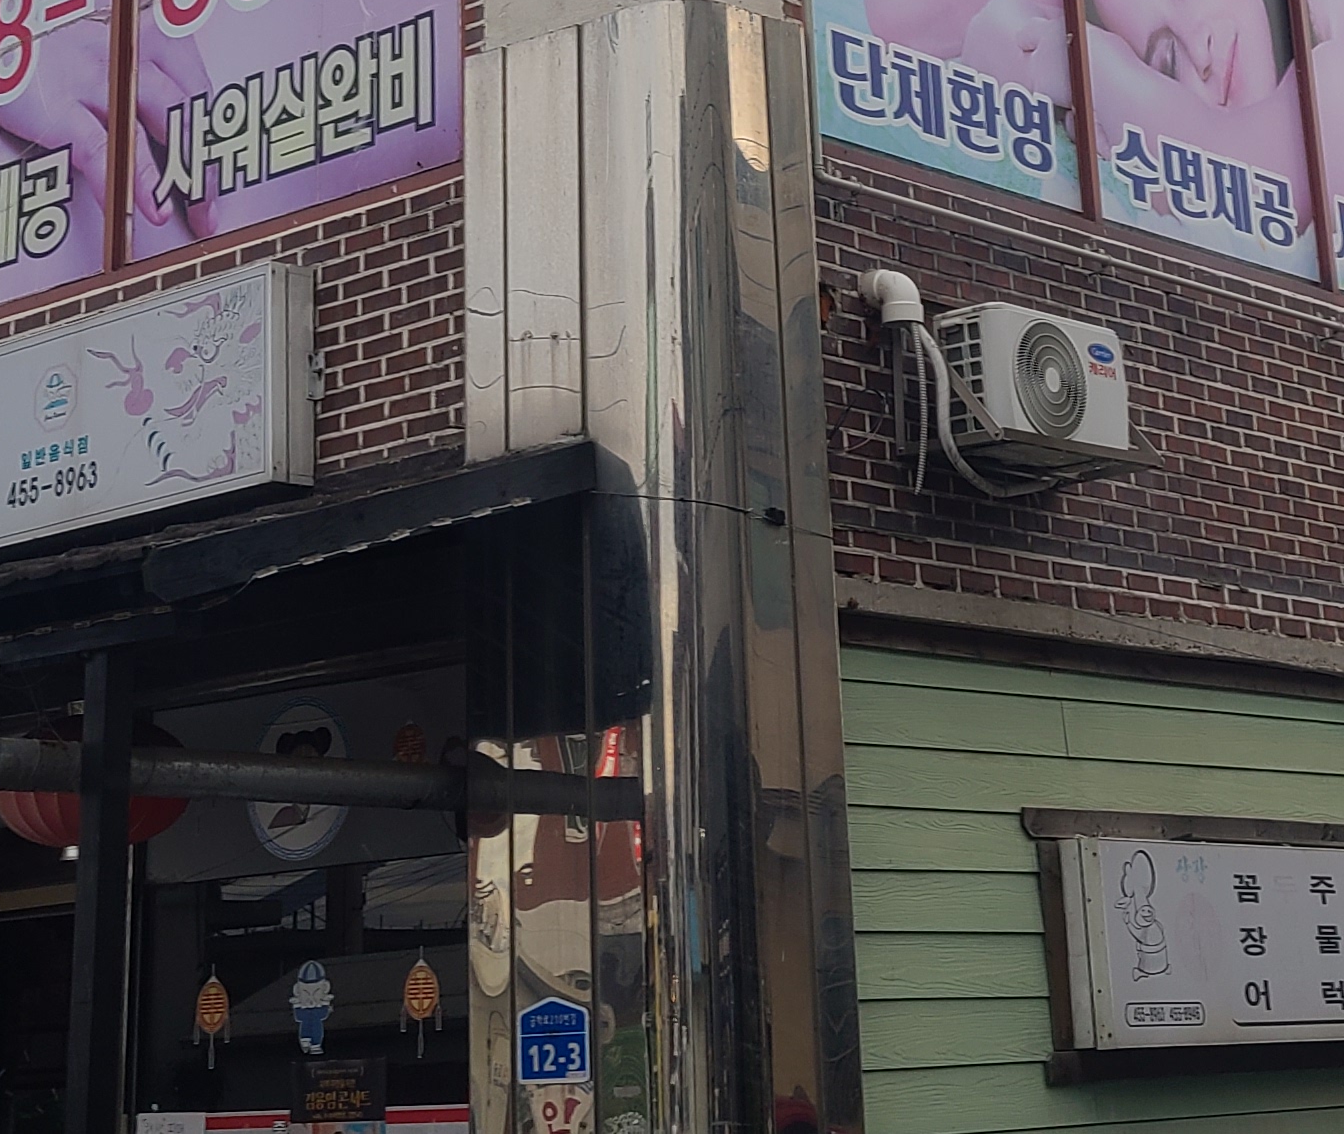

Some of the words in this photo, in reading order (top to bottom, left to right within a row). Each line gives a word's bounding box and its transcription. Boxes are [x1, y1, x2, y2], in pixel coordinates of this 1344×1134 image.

[827, 22, 1056, 175] 단체환영
[1111, 122, 1298, 248] 수면제공
[7, 462, 99, 509] 455-8963
[1232, 873, 1273, 1010] 꼼장어
[528, 1042, 582, 1072] 12-3
